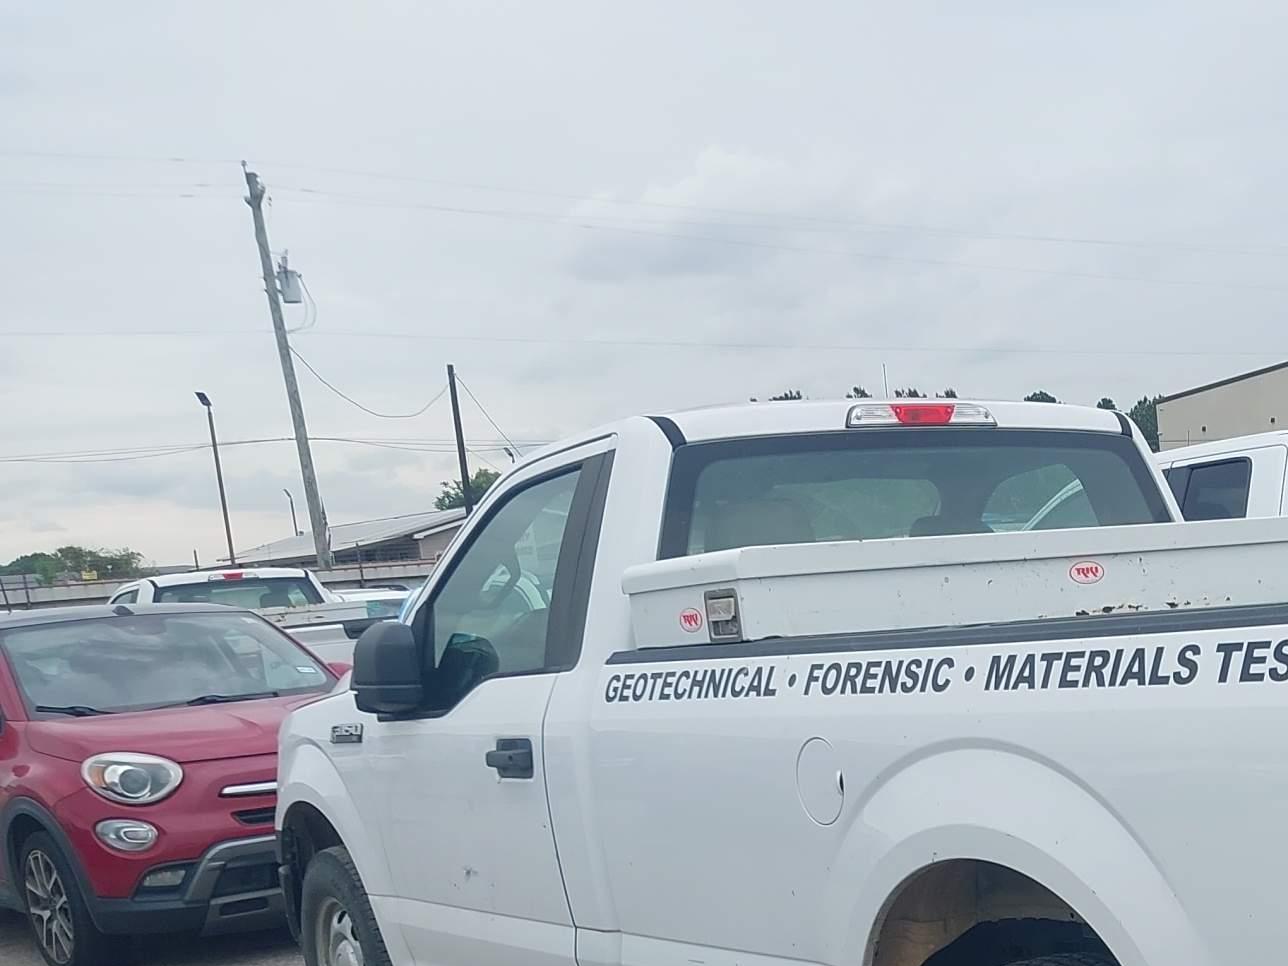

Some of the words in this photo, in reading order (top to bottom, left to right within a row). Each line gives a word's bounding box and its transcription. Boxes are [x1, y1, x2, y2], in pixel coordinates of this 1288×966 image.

[605, 665, 777, 703] GEOTECHNICAL
[803, 658, 955, 696] FORENSIC
[983, 645, 1201, 691] MATERIALS
